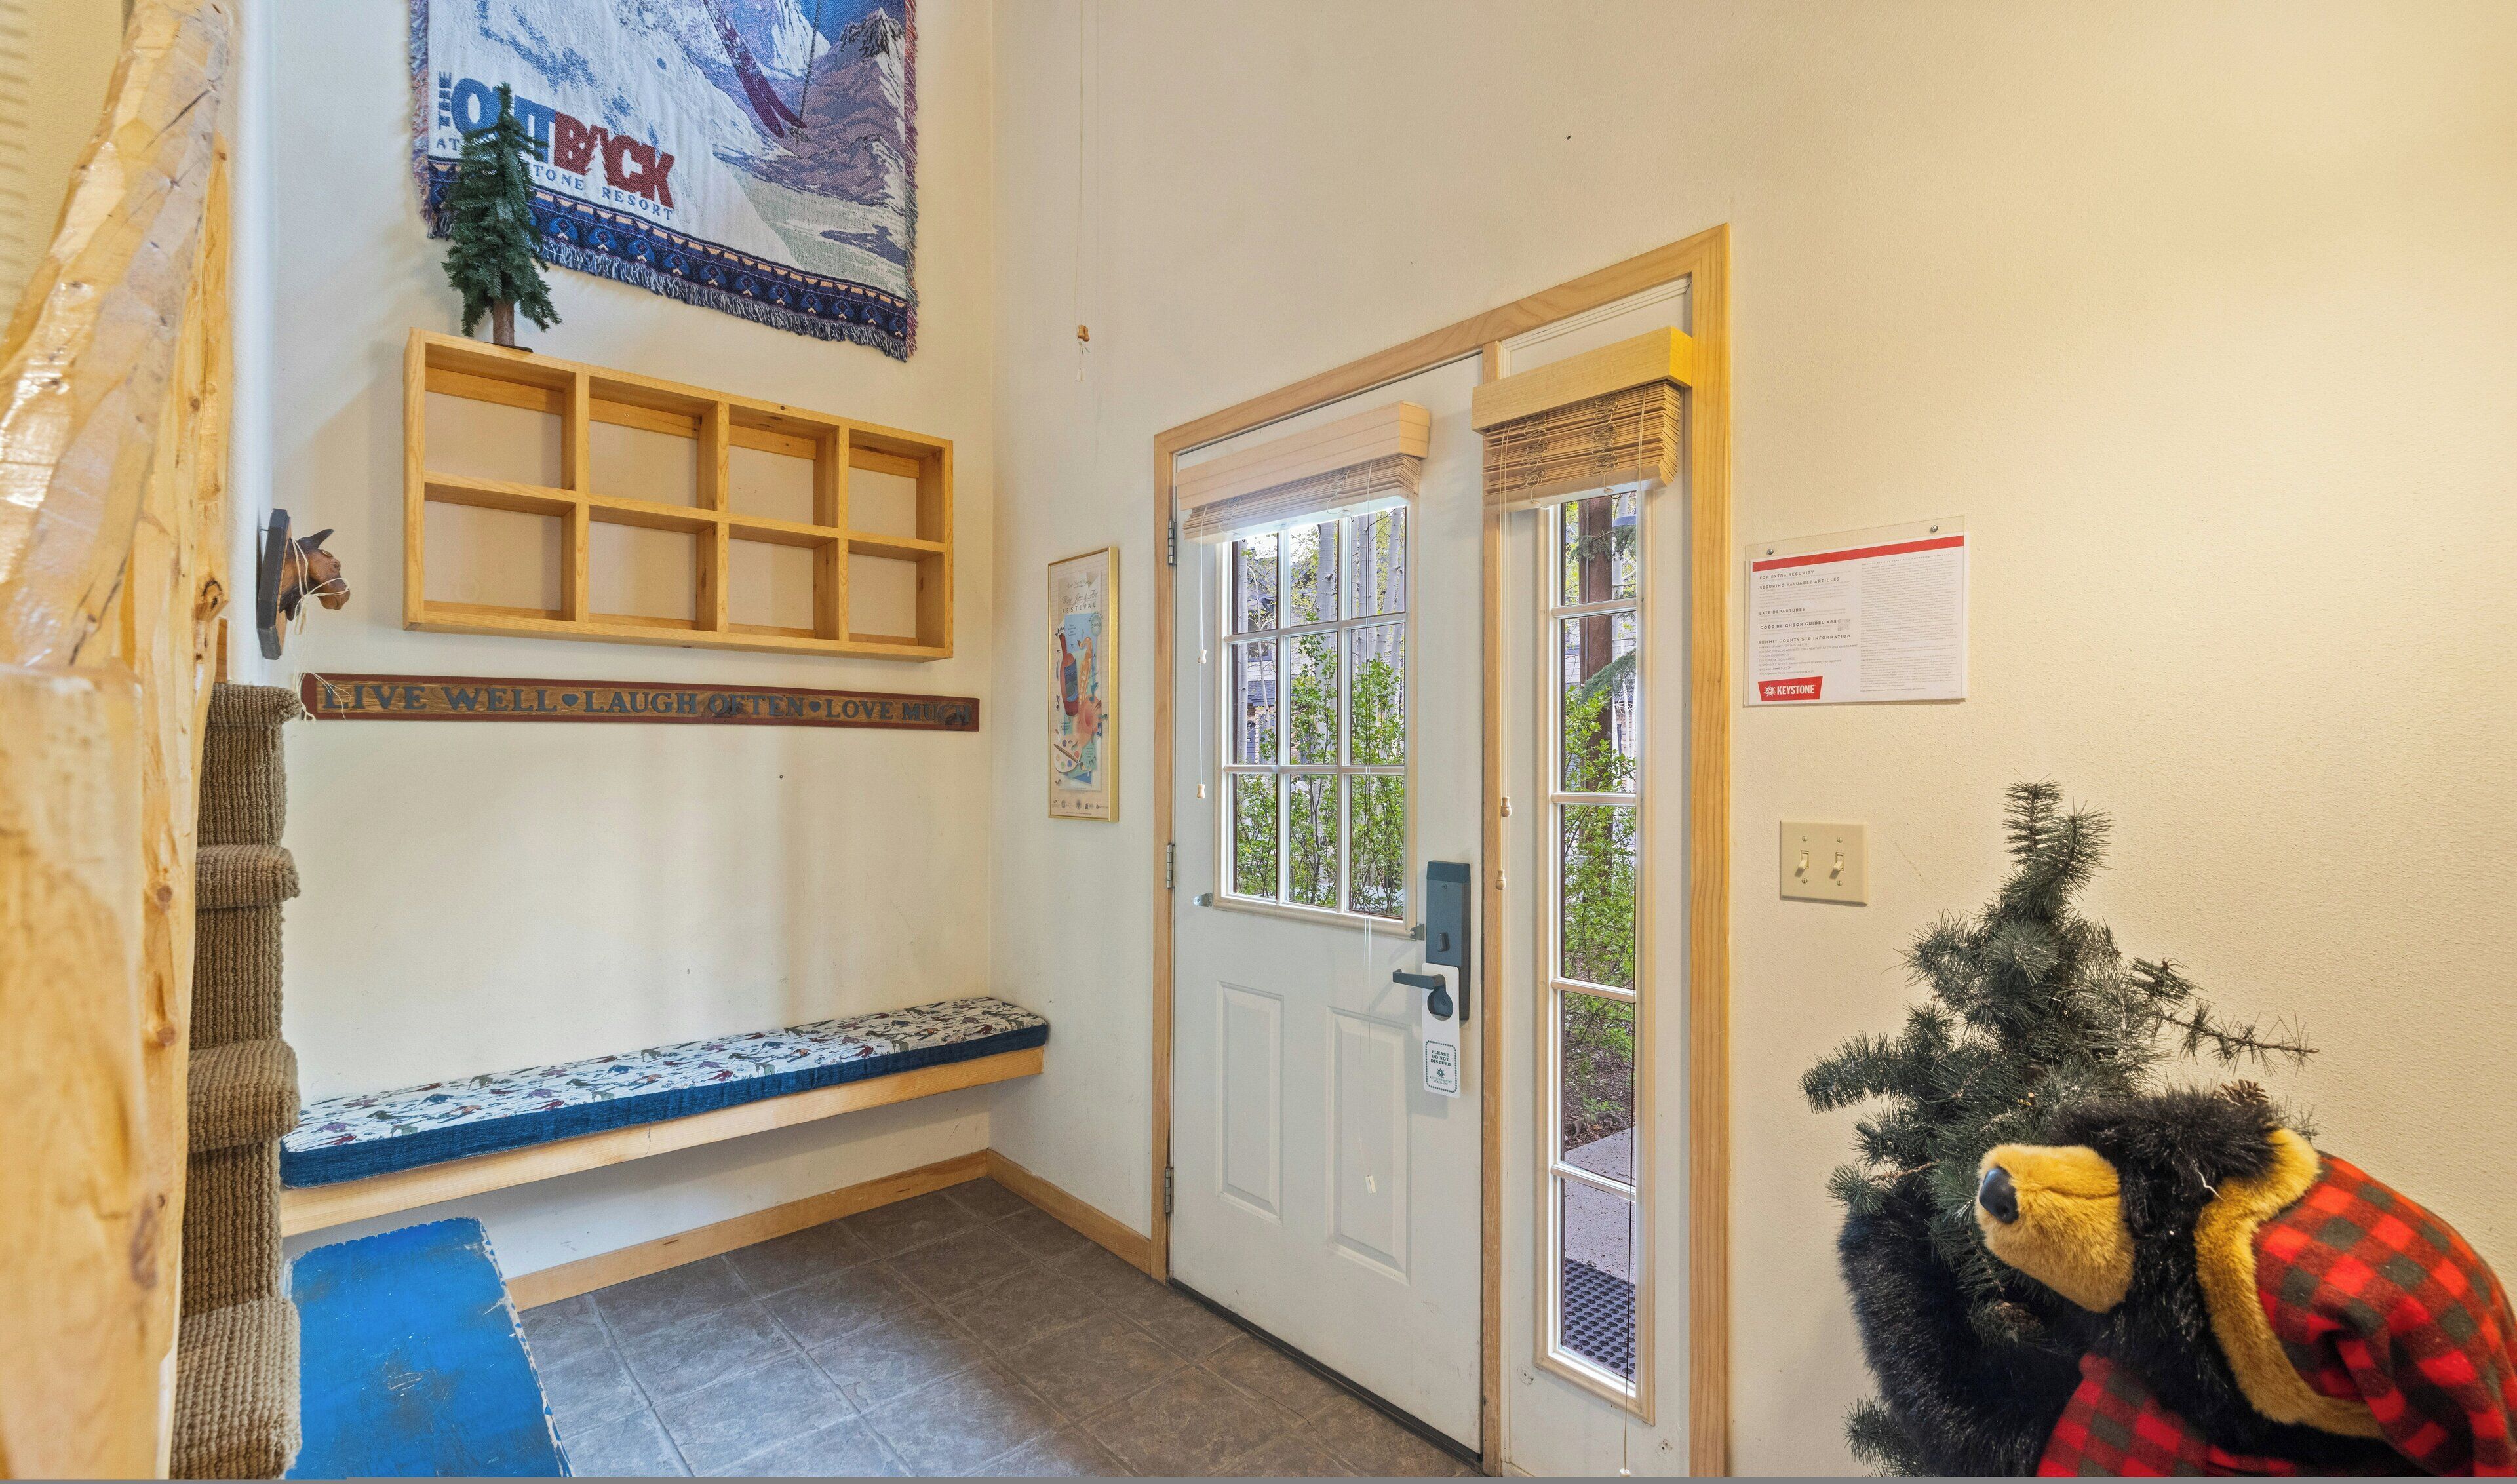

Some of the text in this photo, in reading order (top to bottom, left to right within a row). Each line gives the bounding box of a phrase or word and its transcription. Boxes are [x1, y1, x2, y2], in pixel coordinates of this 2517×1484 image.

[438, 71, 452, 129] THE
[437, 138, 459, 151] AT
[602, 186, 675, 222] RESORT
[1062, 602, 1097, 614] FESTIVAL
[322, 684, 971, 724] LIVE WELL LAUGH OFTEN LOVE MUCH
[1777, 684, 1815, 695] KEYSTONE
